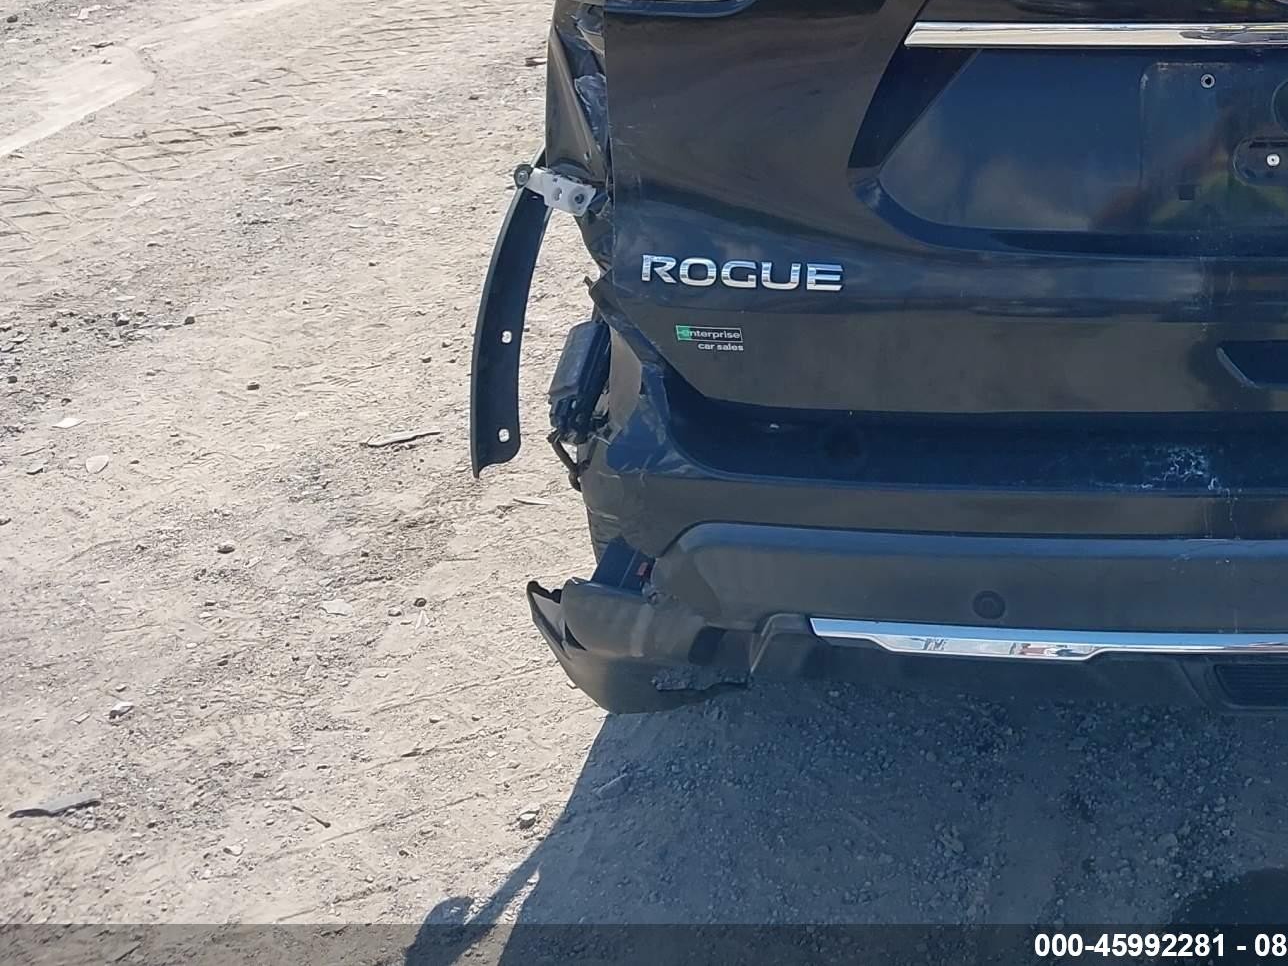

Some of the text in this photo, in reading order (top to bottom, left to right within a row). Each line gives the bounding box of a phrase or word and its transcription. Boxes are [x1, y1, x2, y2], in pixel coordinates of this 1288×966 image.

[641, 254, 844, 291] ROGUE
[679, 328, 741, 340] enterprise
[698, 342, 744, 351] car sales
